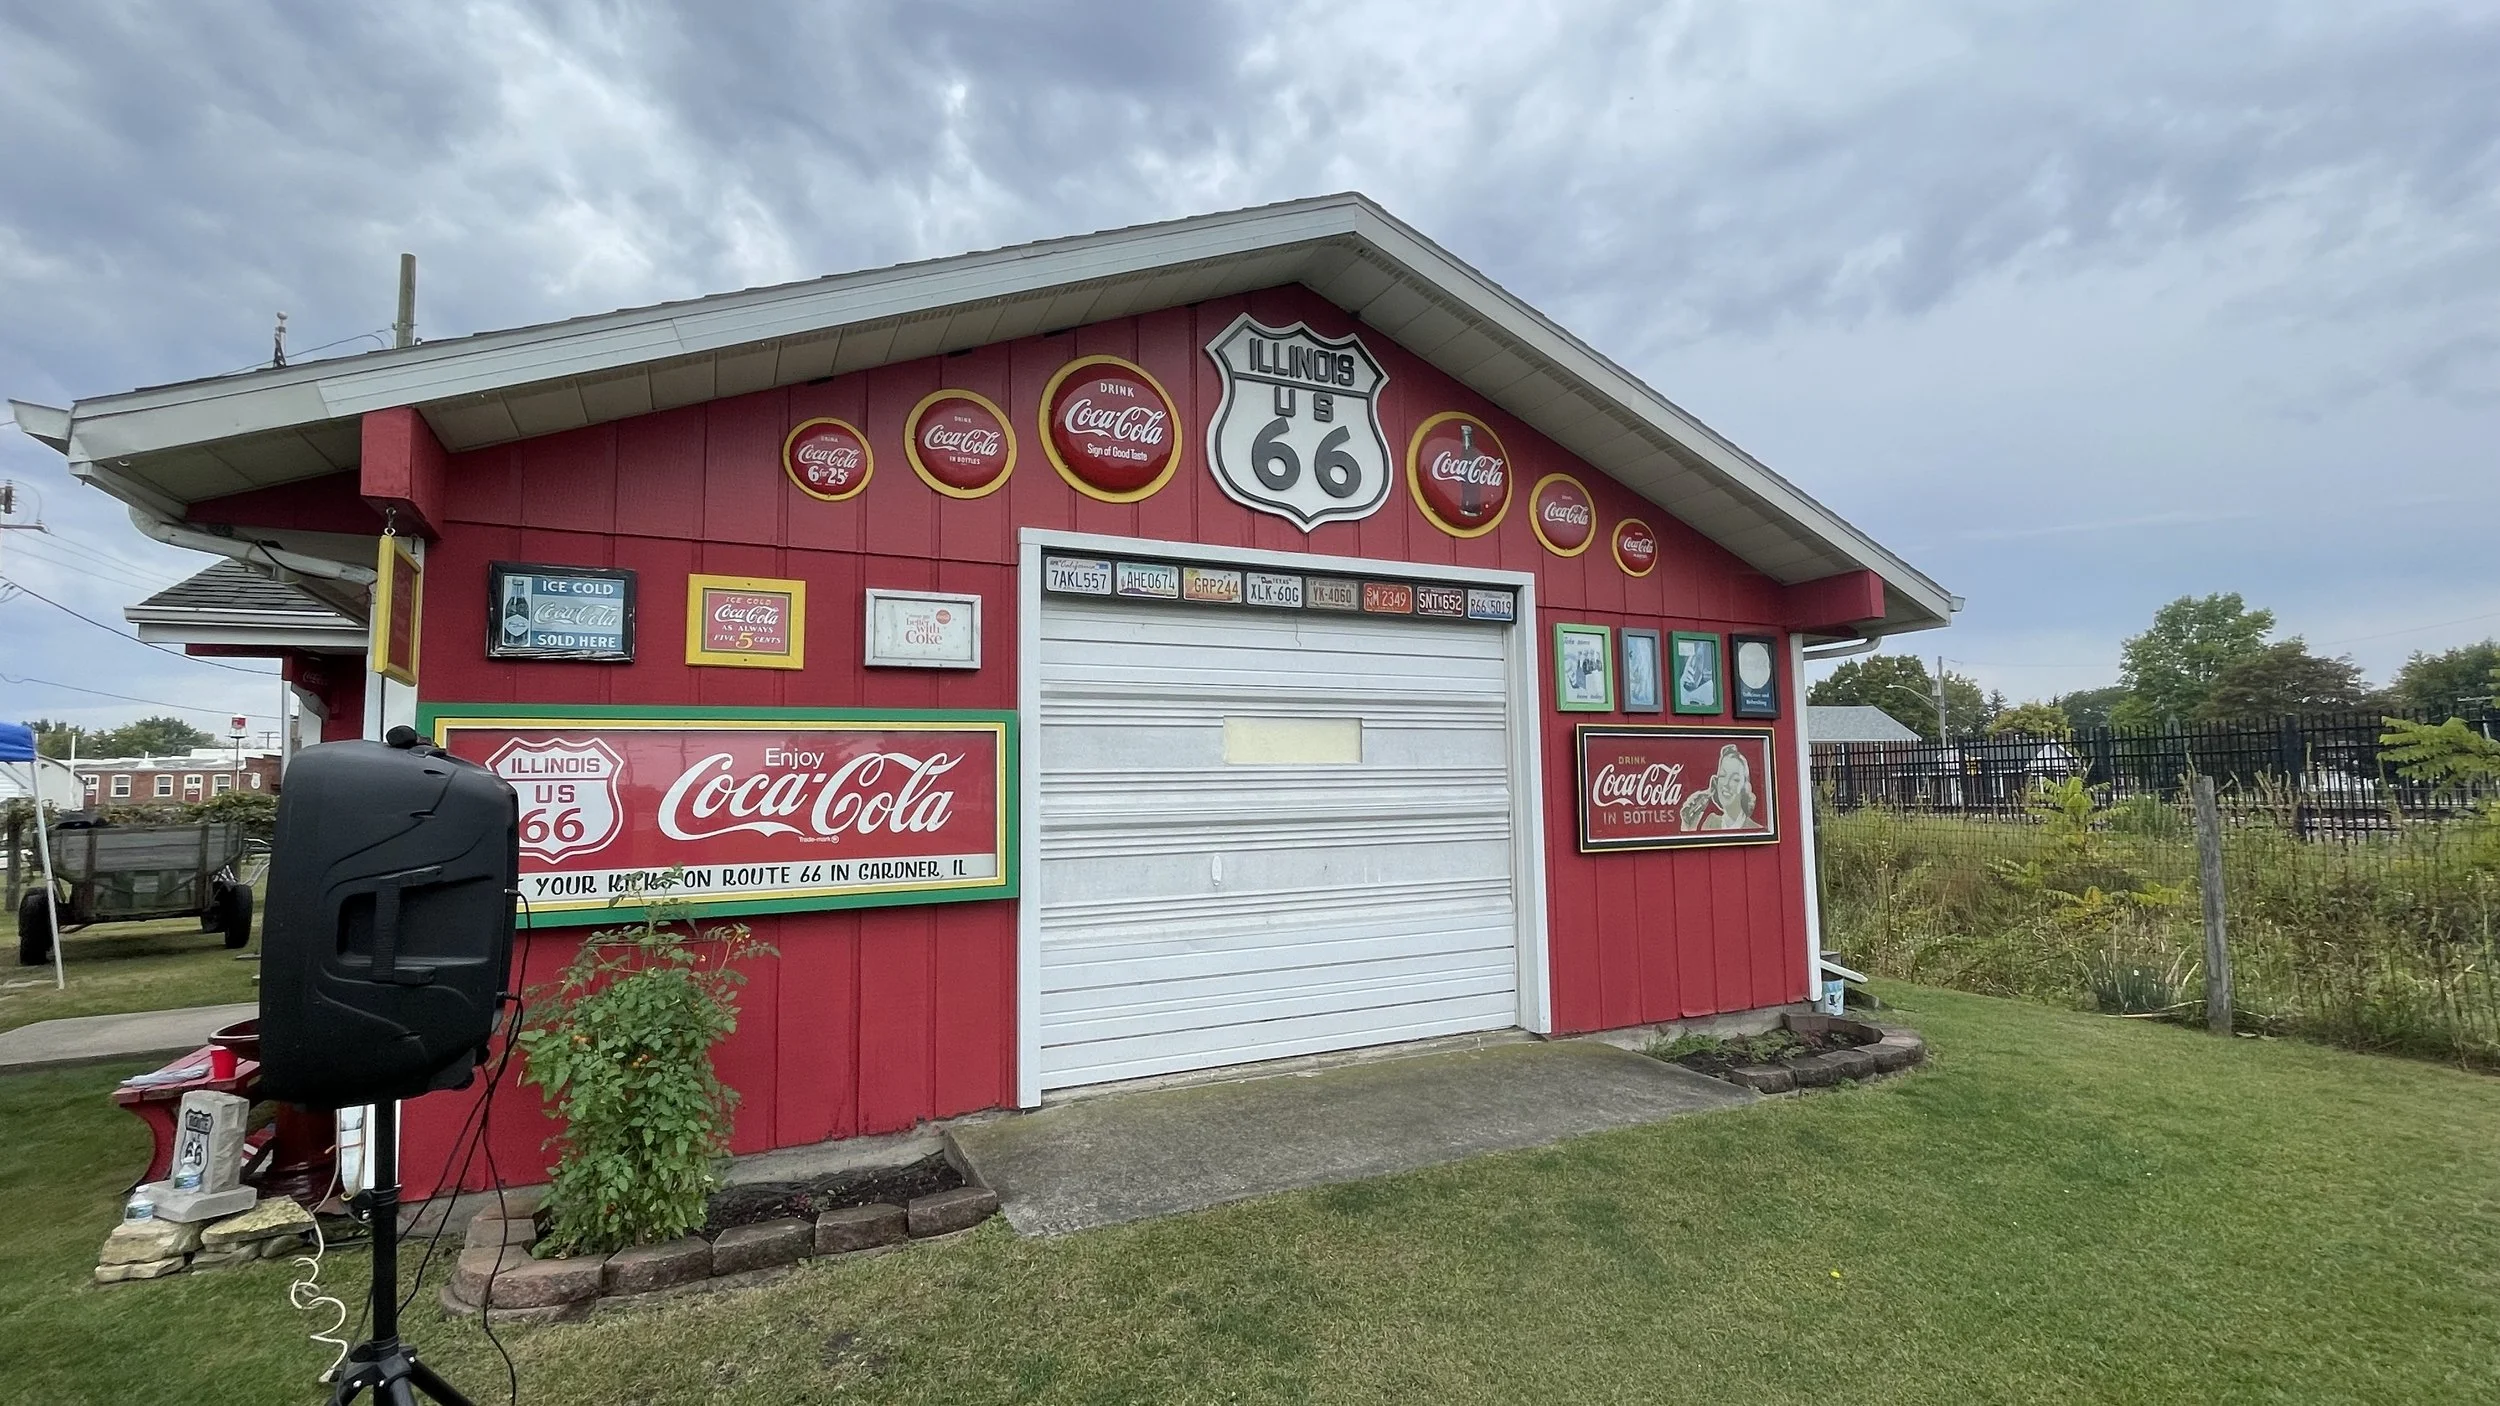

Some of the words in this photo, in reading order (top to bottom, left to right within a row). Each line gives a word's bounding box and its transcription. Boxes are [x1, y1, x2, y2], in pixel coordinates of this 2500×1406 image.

[1249, 337, 1355, 387] ILLINOIS
[1100, 382, 1135, 398] DRINK
[1064, 398, 1167, 445] Coca-Cola
[924, 424, 1001, 456] Coca-Cola
[797, 444, 860, 469] Coca-Cola
[1087, 443, 1103, 457] Sign
[1103, 446, 1112, 456] of
[1112, 446, 1130, 459] Good
[1130, 448, 1148, 461] Taste
[1251, 416, 1362, 499] 66
[808, 465, 820, 482] 6
[1431, 450, 1504, 487] Coca-Cola
[542, 580, 568, 593] ICE
[572, 582, 614, 595] COLD
[1051, 569, 1107, 590] 7AKL557
[1194, 577, 1239, 596] GRP244
[725, 596, 741, 604] ICE
[1381, 591, 1407, 607] 2349
[714, 603, 780, 625] Coca-Cola
[738, 625, 774, 633] ALWAYS
[905, 629, 943, 645] Coke
[537, 634, 575, 646] SOLD
[579, 636, 616, 648] HERE
[713, 634, 736, 642] FIVE
[735, 632, 754, 649] 5
[754, 636, 781, 644] CENTS
[511, 757, 601, 774] ILLINOIS
[765, 747, 825, 770] Enjoy
[1618, 756, 1647, 765] DRINK
[535, 784, 576, 804] US
[1592, 763, 1685, 807] Coca-Cola
[657, 752, 966, 841] Coca-Cola
[520, 807, 585, 843] 66
[1603, 811, 1617, 825] IN
[1623, 809, 1675, 825] BOTTLES
[535, 875, 598, 897] YOUR
[683, 868, 712, 889] ON
[722, 866, 791, 887] ROUTE
[799, 864, 822, 883] 66
[830, 863, 850, 881] IN
[952, 858, 968, 876] IL
